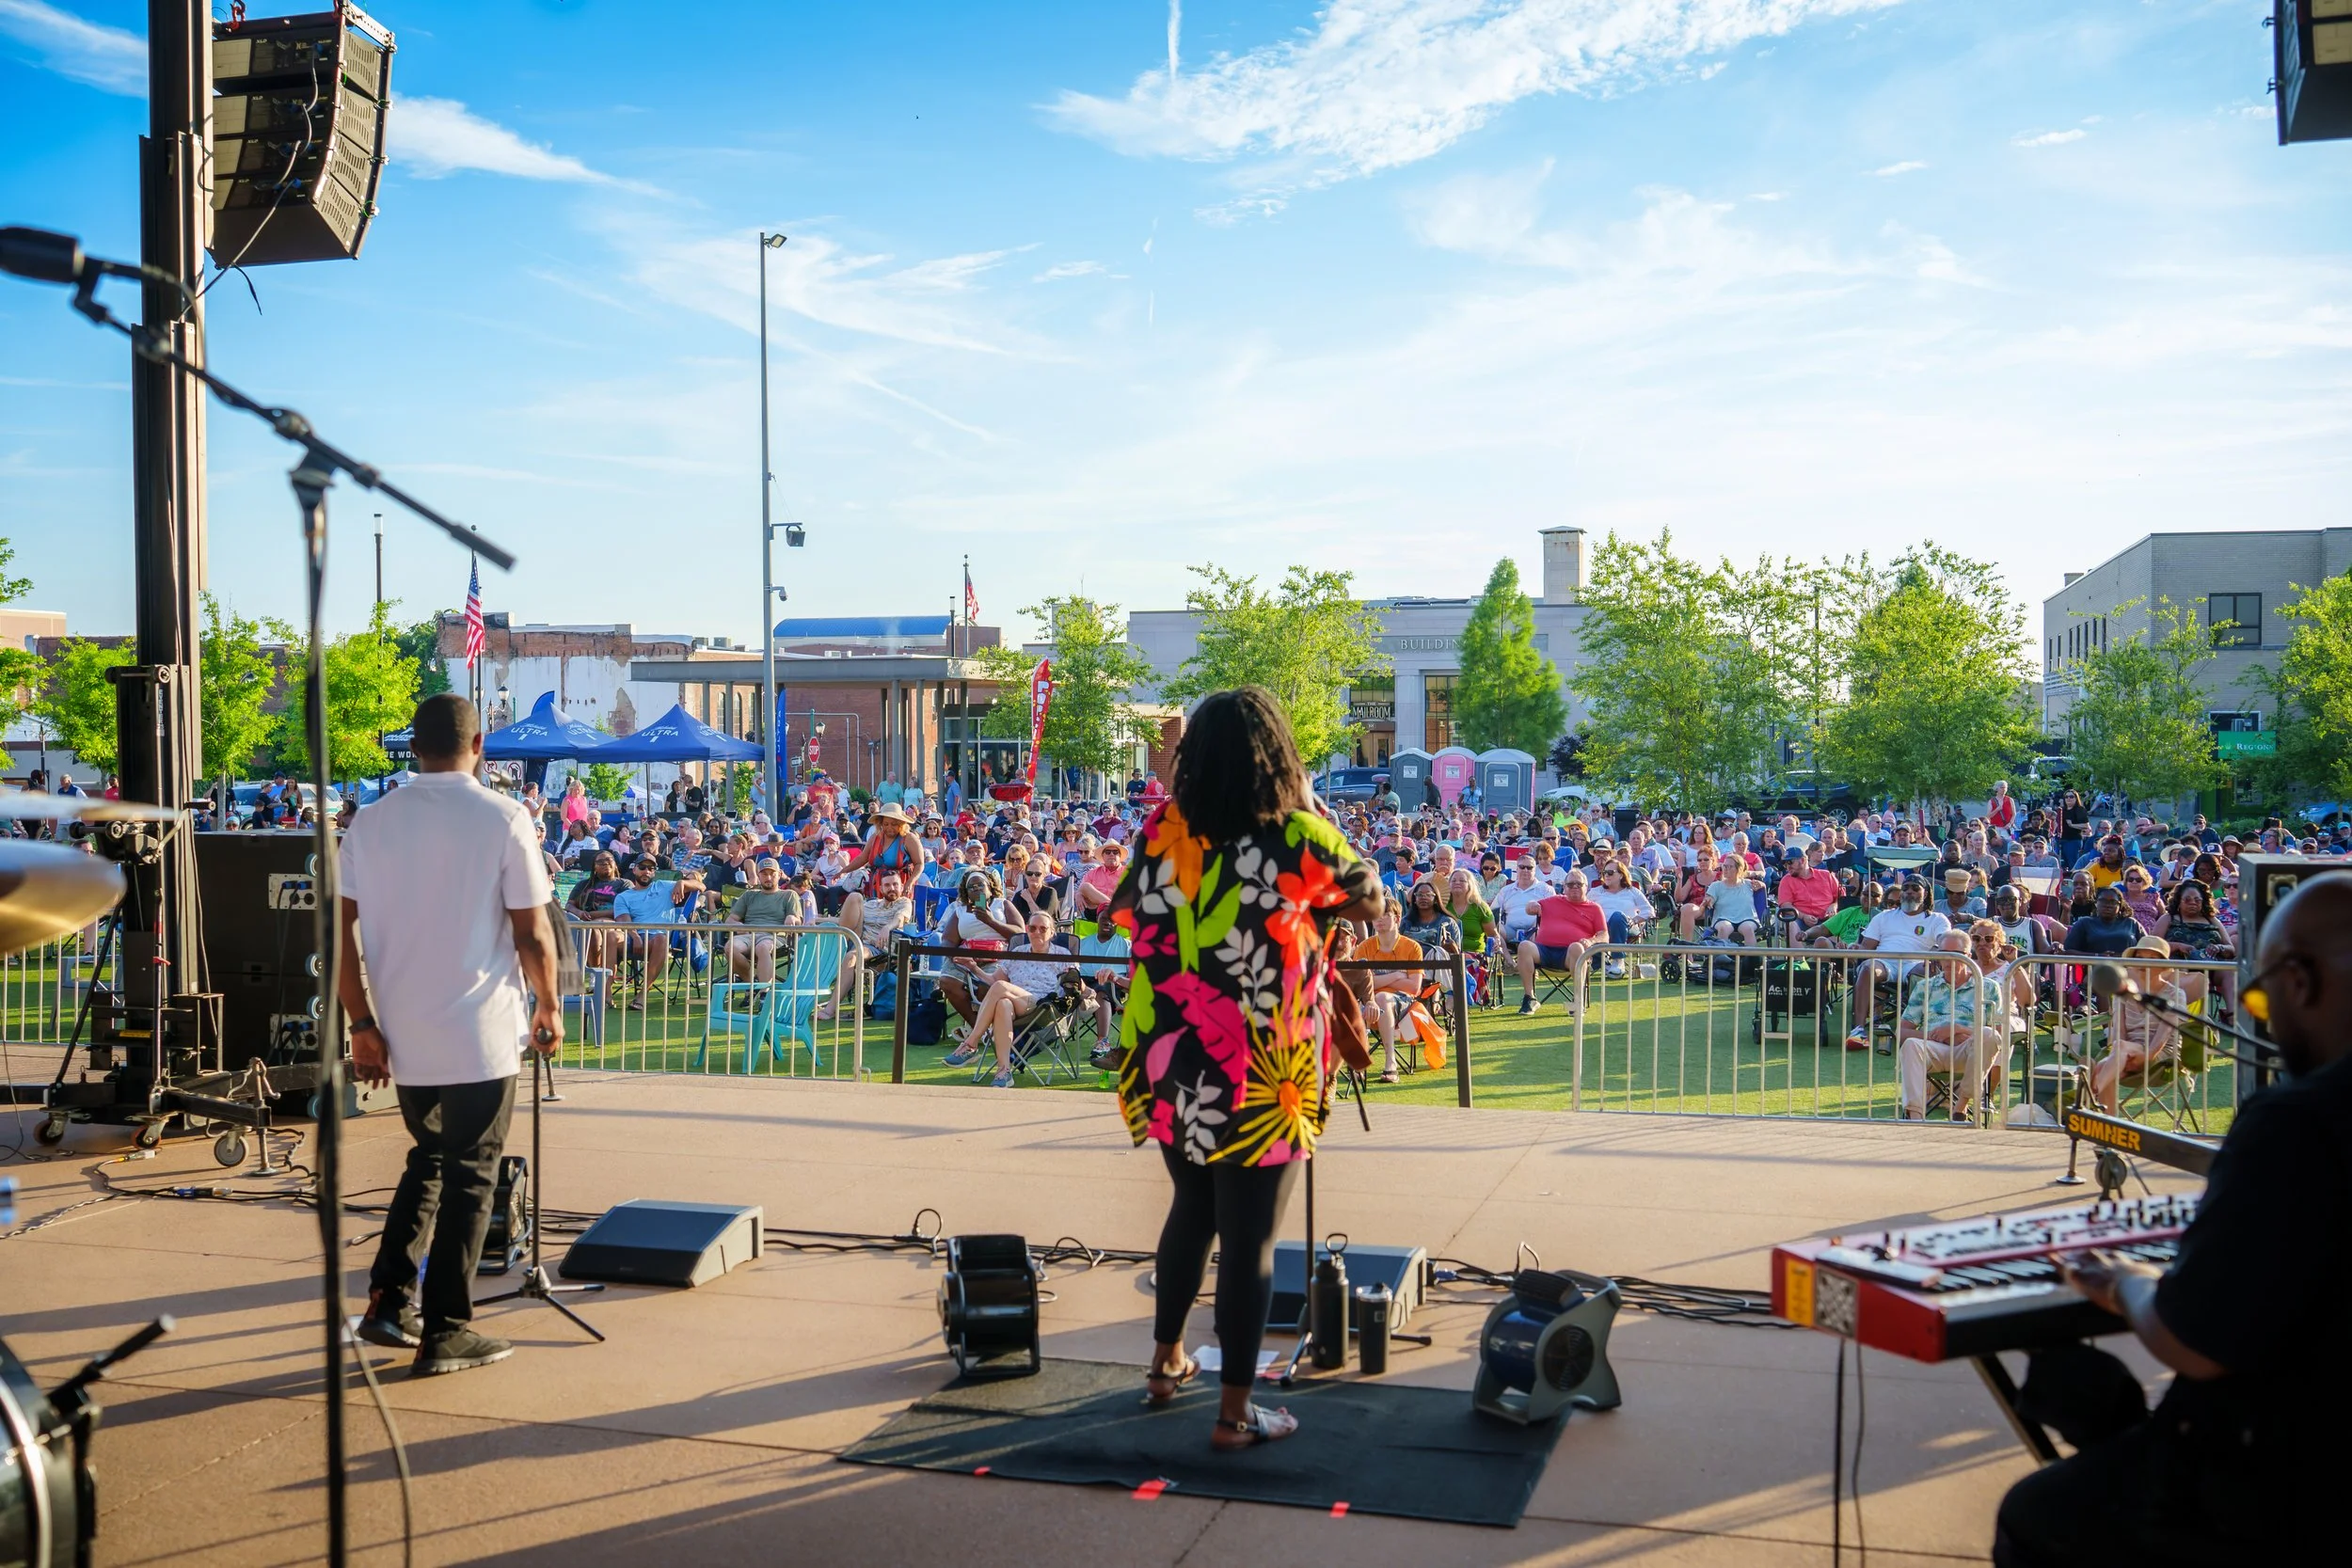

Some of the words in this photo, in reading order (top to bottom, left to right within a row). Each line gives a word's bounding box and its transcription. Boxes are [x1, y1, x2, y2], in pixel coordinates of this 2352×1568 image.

[1400, 640, 1467, 650] BUILDIN
[1352, 706, 1391, 721] MAILROOM
[511, 727, 548, 736] ULTRA
[809, 745, 818, 755] STOP
[2068, 1114, 2141, 1151] SUMNER
